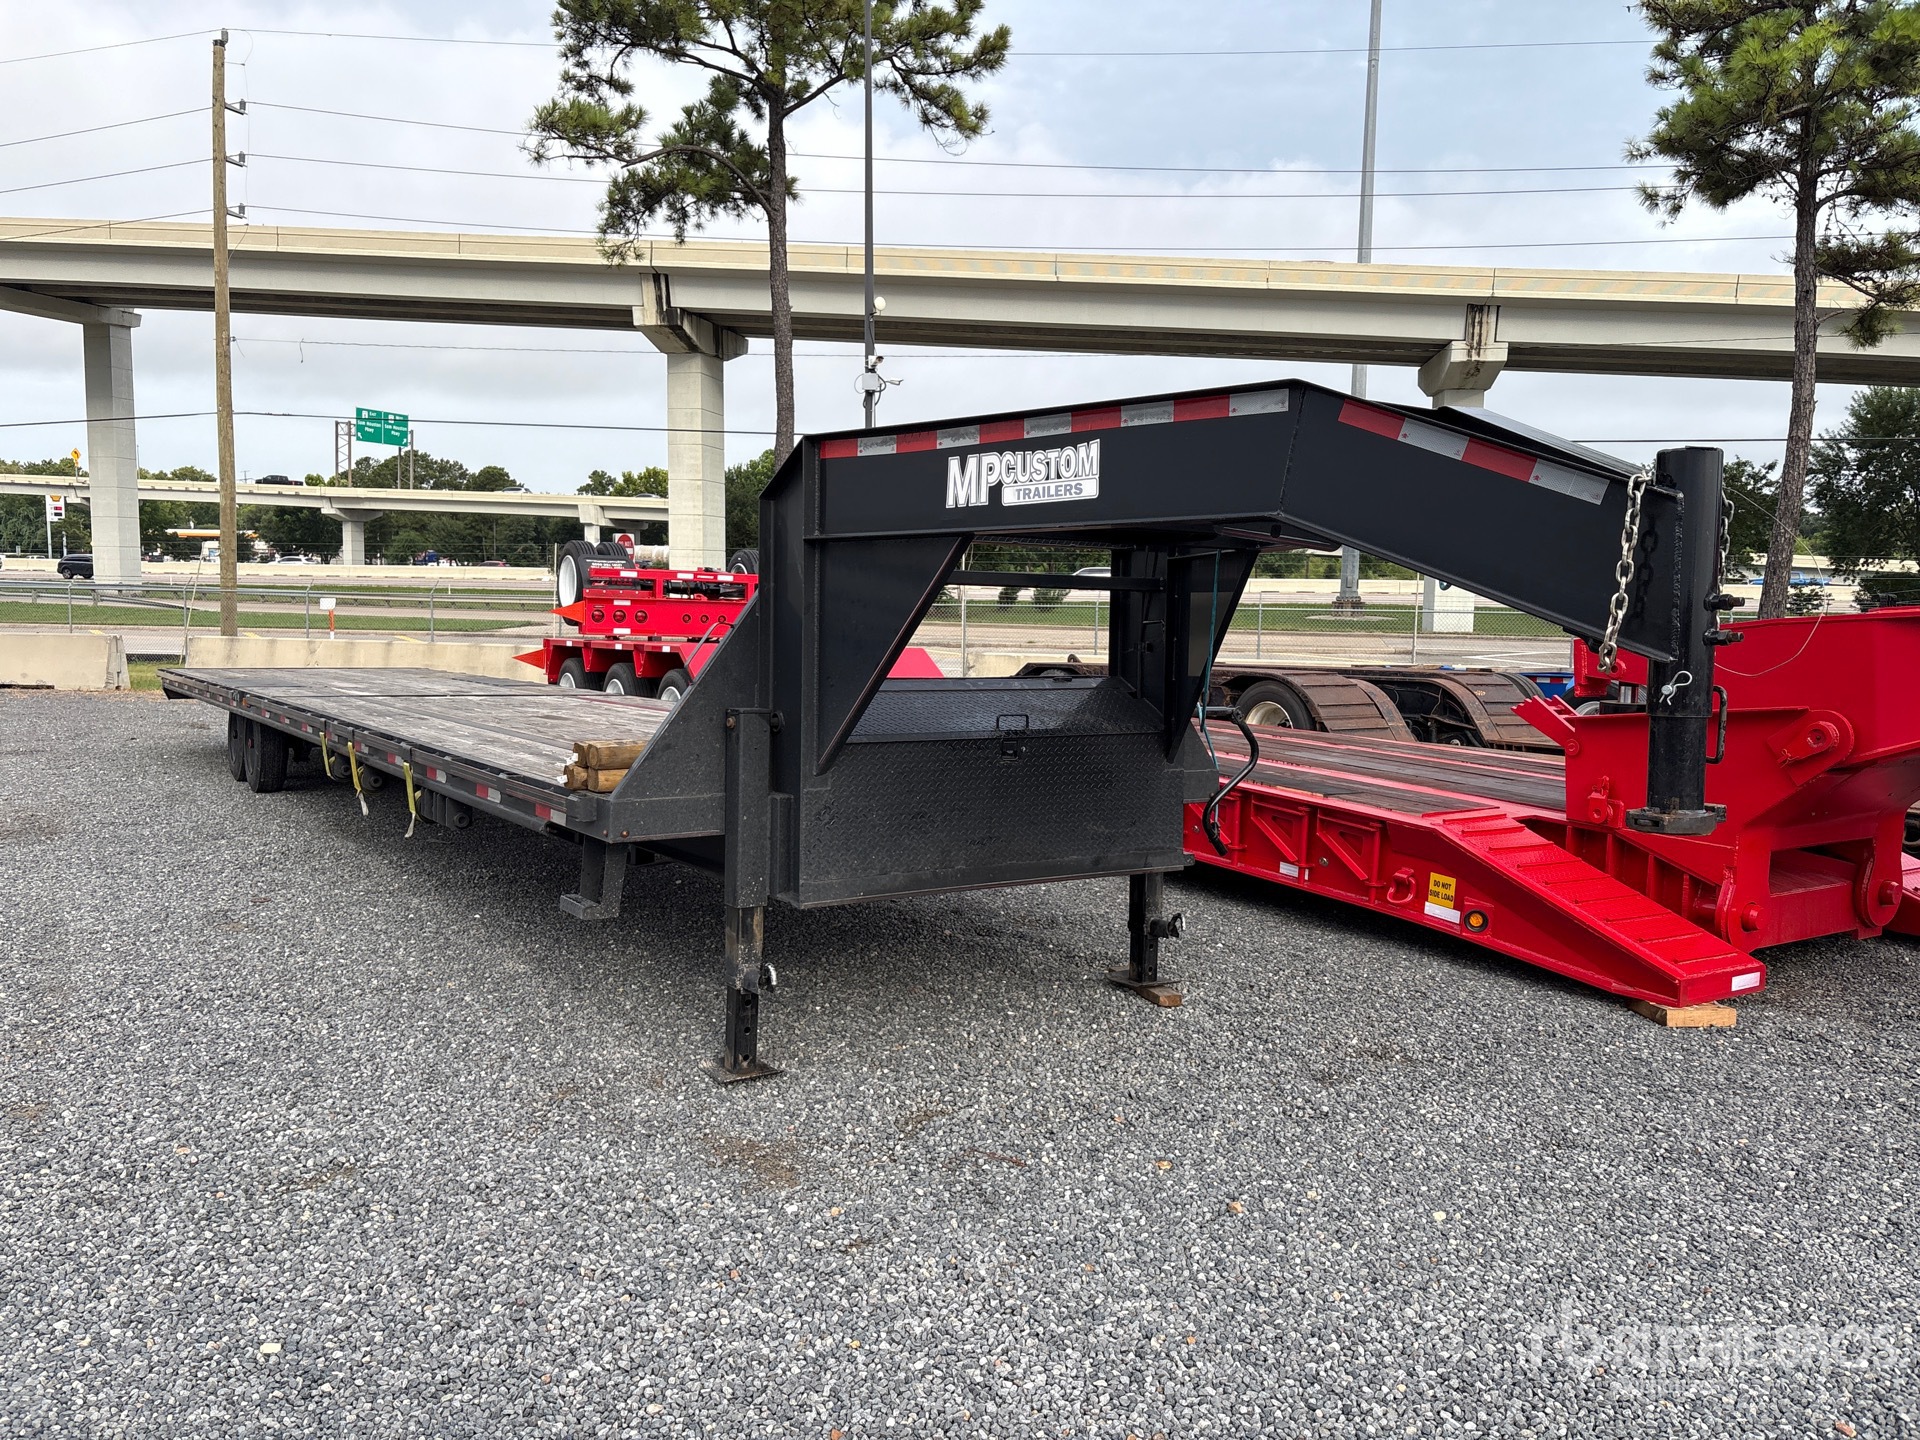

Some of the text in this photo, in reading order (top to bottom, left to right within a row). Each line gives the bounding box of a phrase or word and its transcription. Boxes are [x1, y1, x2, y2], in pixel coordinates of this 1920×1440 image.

[1015, 482, 1083, 501] TRAILERS
[1441, 882, 1451, 890] NOT
[1430, 889, 1453, 902] SIDE LOAD
